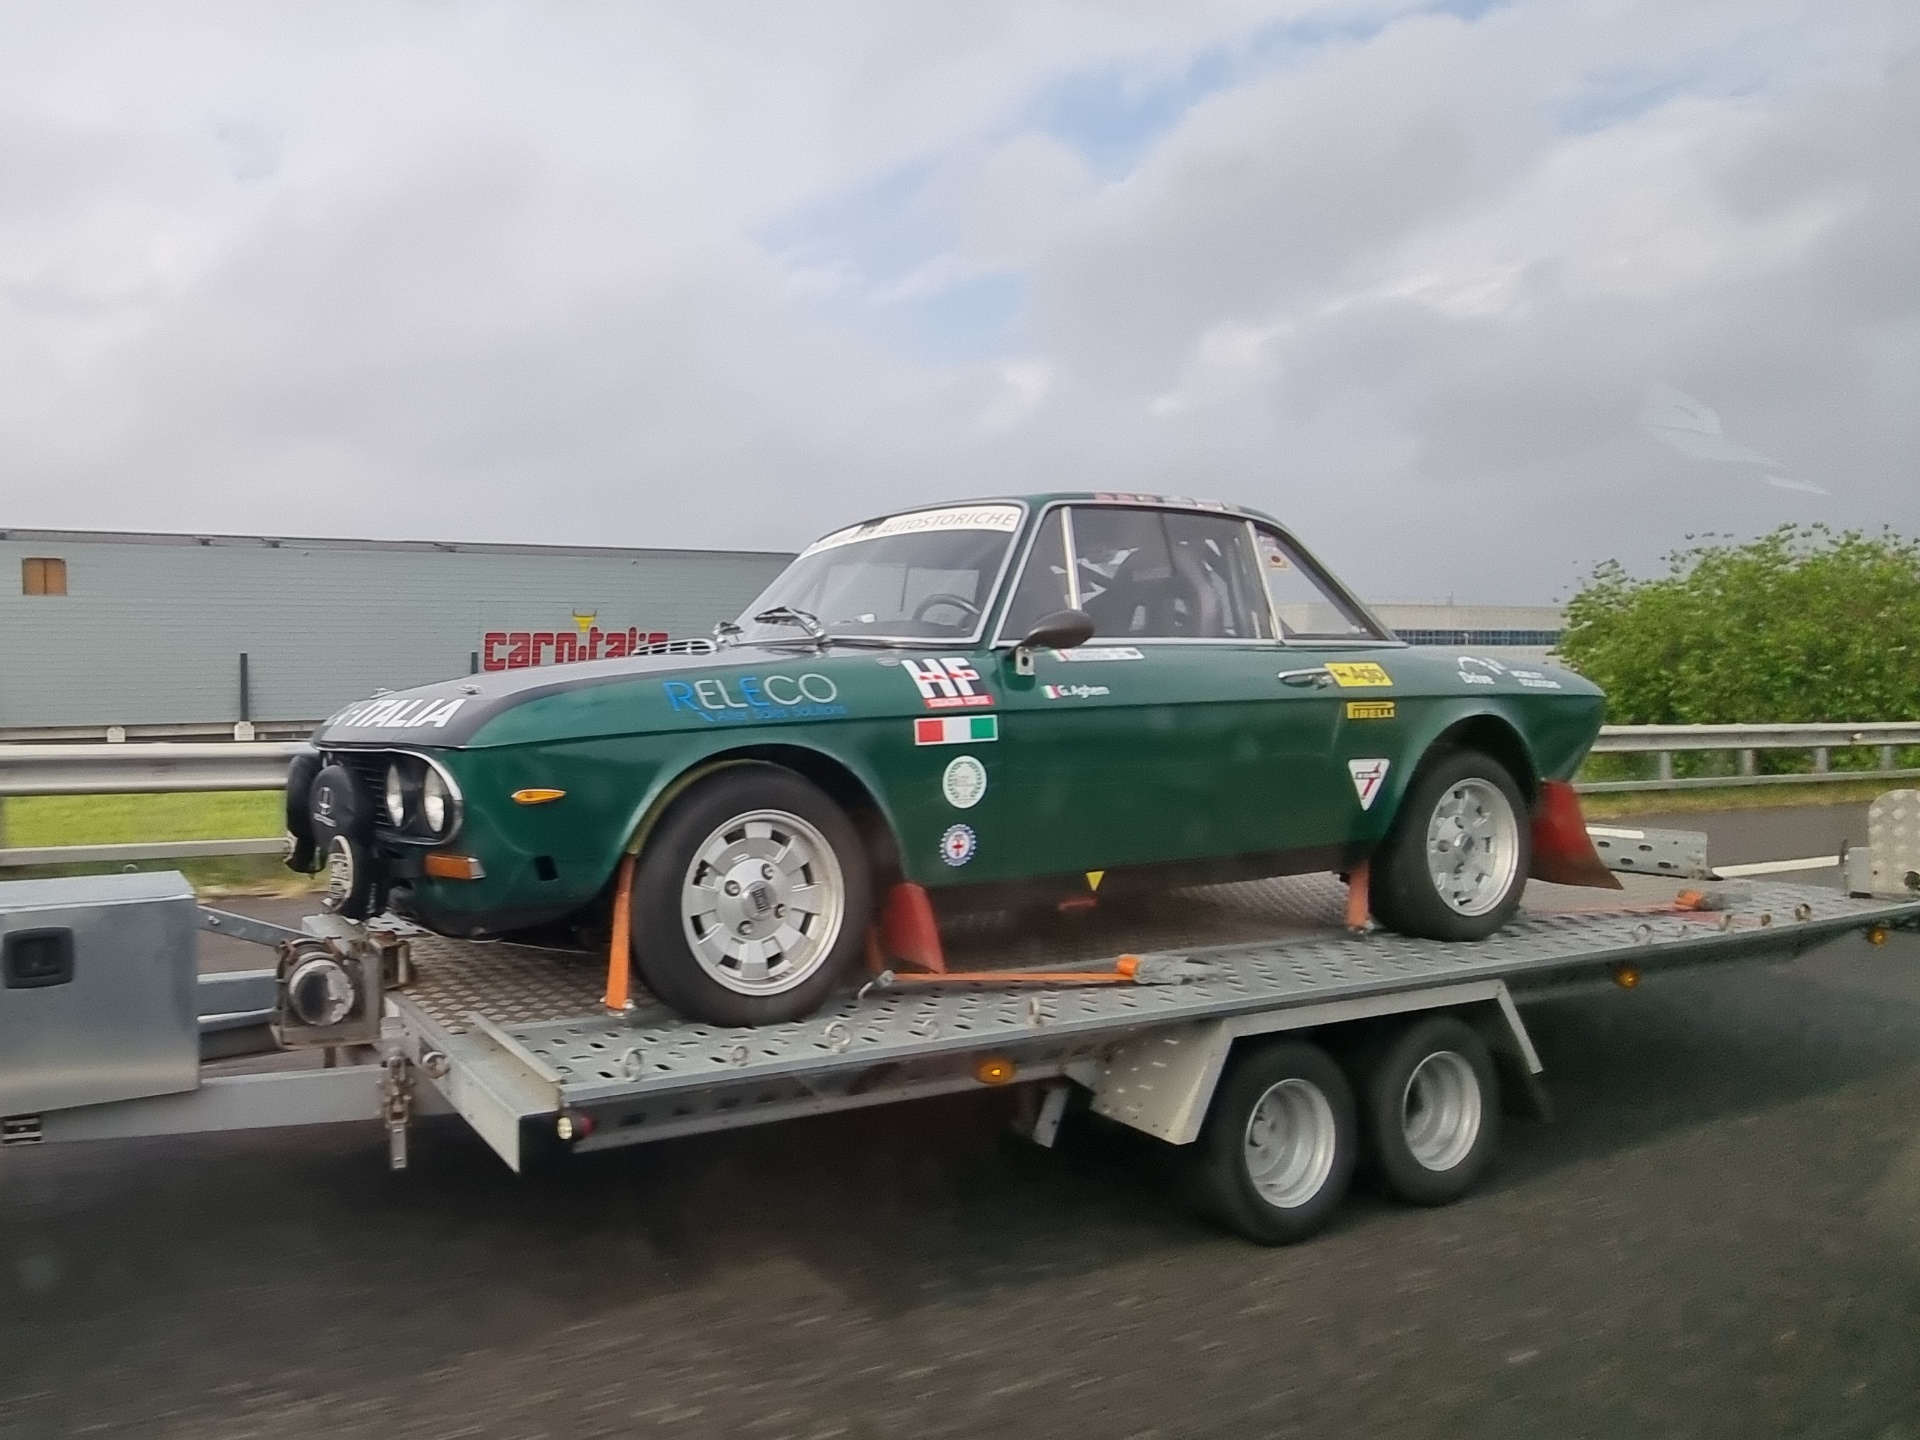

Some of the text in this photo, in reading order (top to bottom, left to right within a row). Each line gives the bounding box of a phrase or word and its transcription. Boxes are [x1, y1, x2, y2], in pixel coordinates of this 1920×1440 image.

[484, 626, 668, 671] carnital
[663, 673, 838, 712] RELECO
[901, 657, 980, 698] HF
[1346, 701, 1395, 719] PIRELLI
